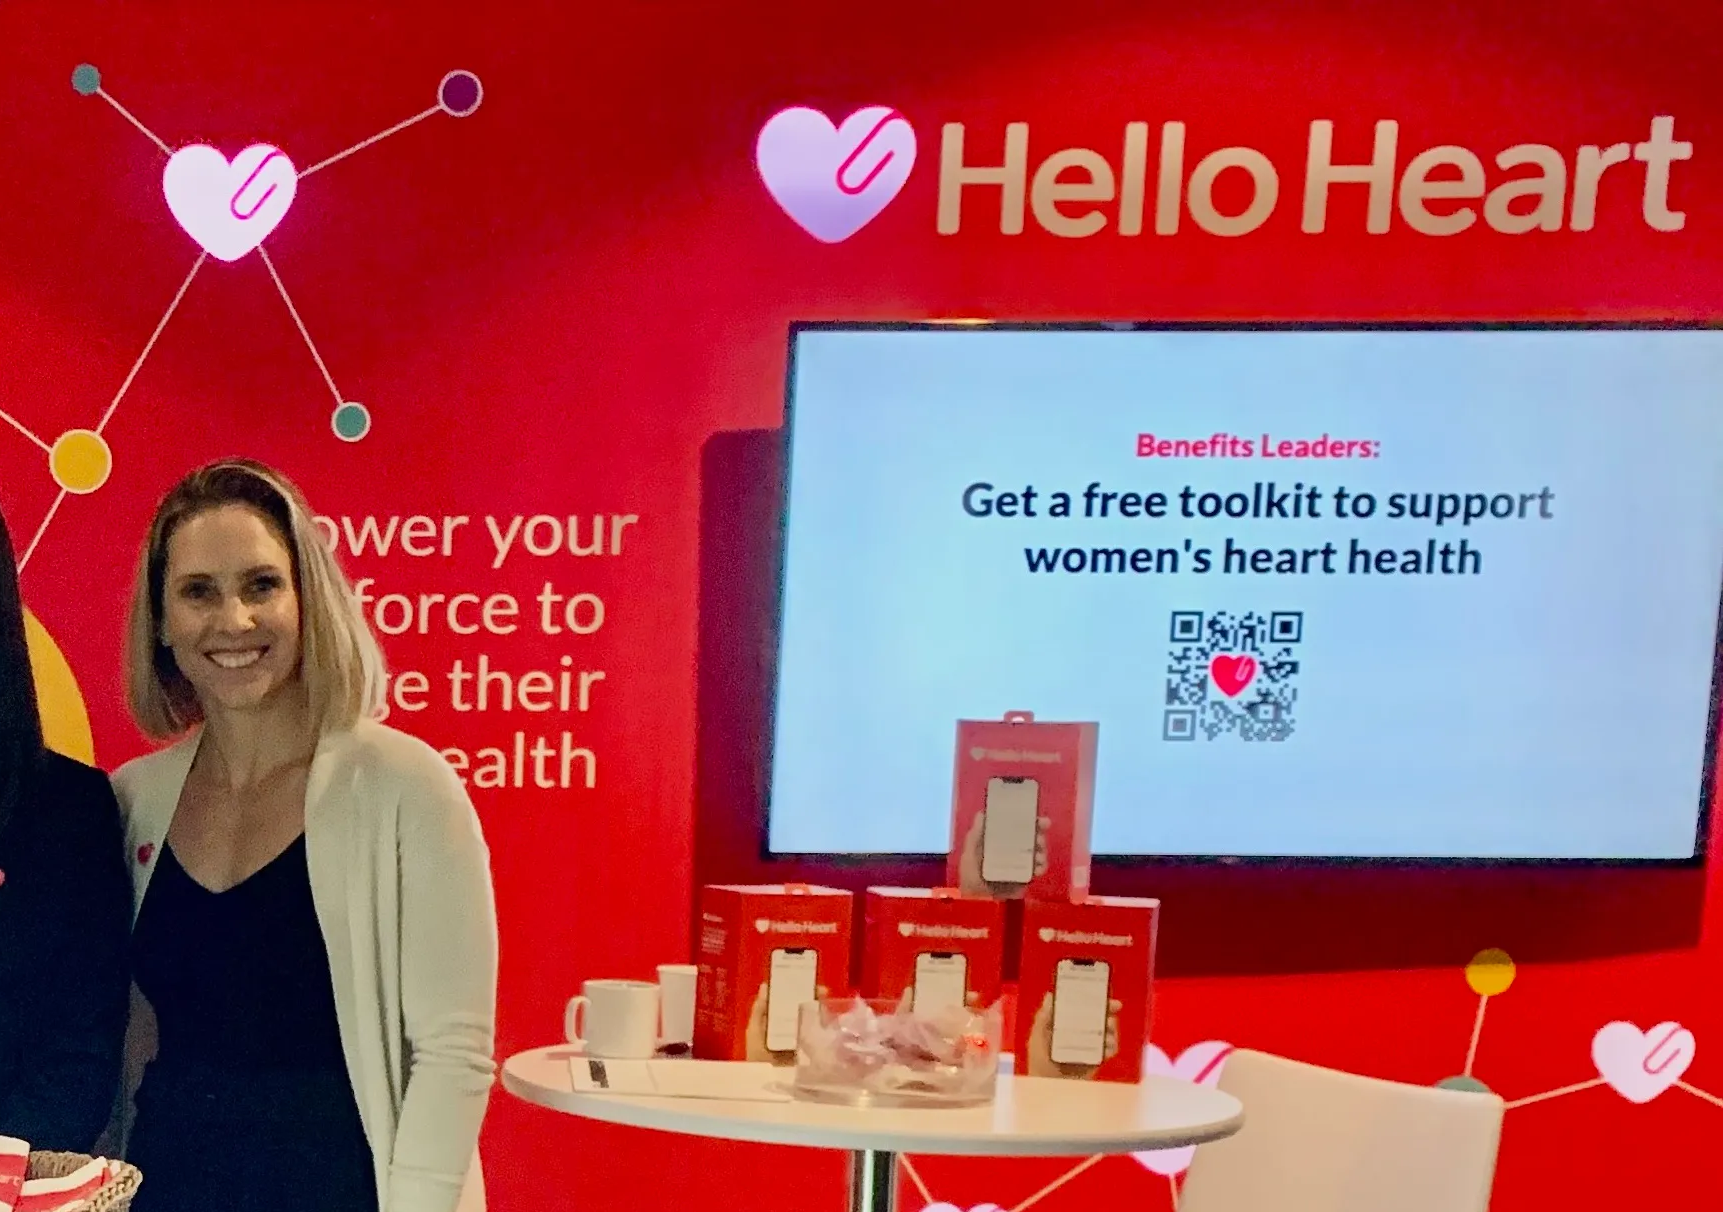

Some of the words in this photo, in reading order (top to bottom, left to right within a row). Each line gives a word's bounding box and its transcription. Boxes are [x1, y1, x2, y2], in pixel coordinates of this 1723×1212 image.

[935, 121, 1280, 238] Hello
[1300, 114, 1694, 236] Heart
[1135, 433, 1255, 458] Benefits
[1261, 433, 1381, 458] Leaders:
[961, 481, 1037, 519] Get
[1048, 491, 1070, 519] a
[1082, 481, 1168, 519] free
[1179, 481, 1322, 519] toolkit
[1333, 487, 1377, 519] to
[1386, 486, 1555, 527] support
[312, 514, 470, 557] ower
[485, 512, 639, 570] your
[1024, 539, 1212, 574] women's
[1223, 539, 1337, 575] heart
[1346, 539, 1482, 575] health
[353, 577, 520, 635] force
[536, 582, 606, 635] to
[446, 654, 606, 712] their
[439, 731, 597, 789] ealth
